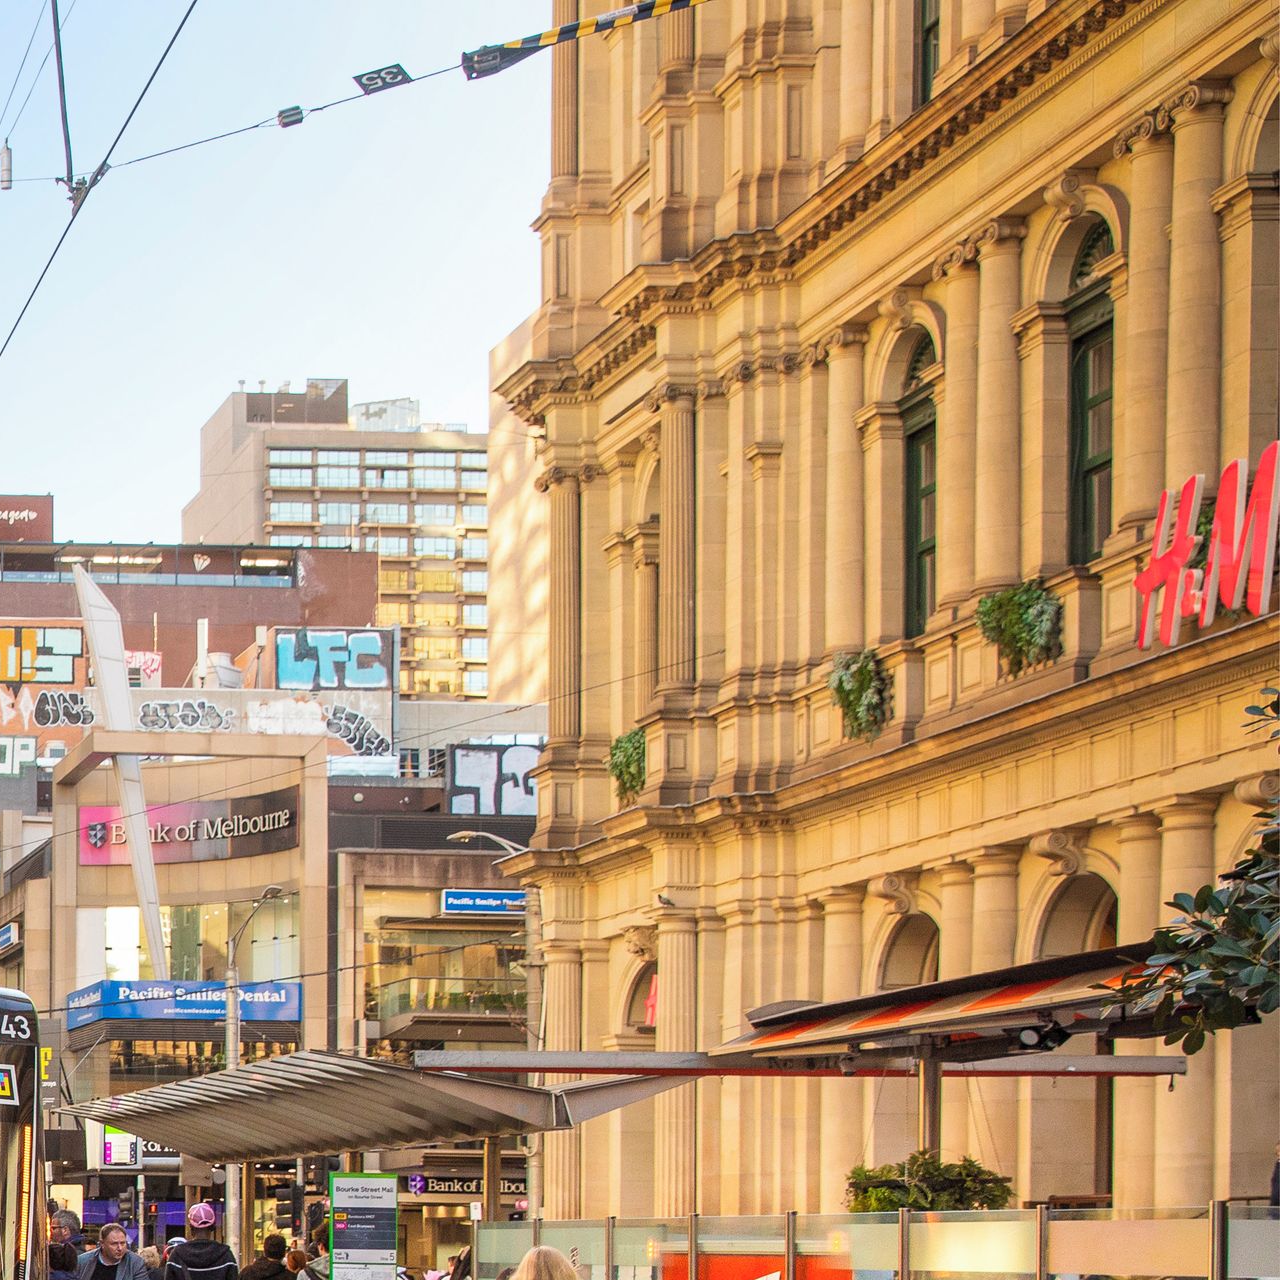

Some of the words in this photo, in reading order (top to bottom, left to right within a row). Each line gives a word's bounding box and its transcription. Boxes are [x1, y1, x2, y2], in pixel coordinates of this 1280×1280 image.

[1133, 440, 1280, 649] H&M
[111, 822, 170, 845] Bnk
[175, 820, 197, 842] of
[203, 808, 290, 840] Melbourne
[119, 987, 172, 1001] Pacific
[428, 1179, 463, 1192] Bank
[464, 1179, 478, 1192] of
[389, 1252, 395, 1261] 5
